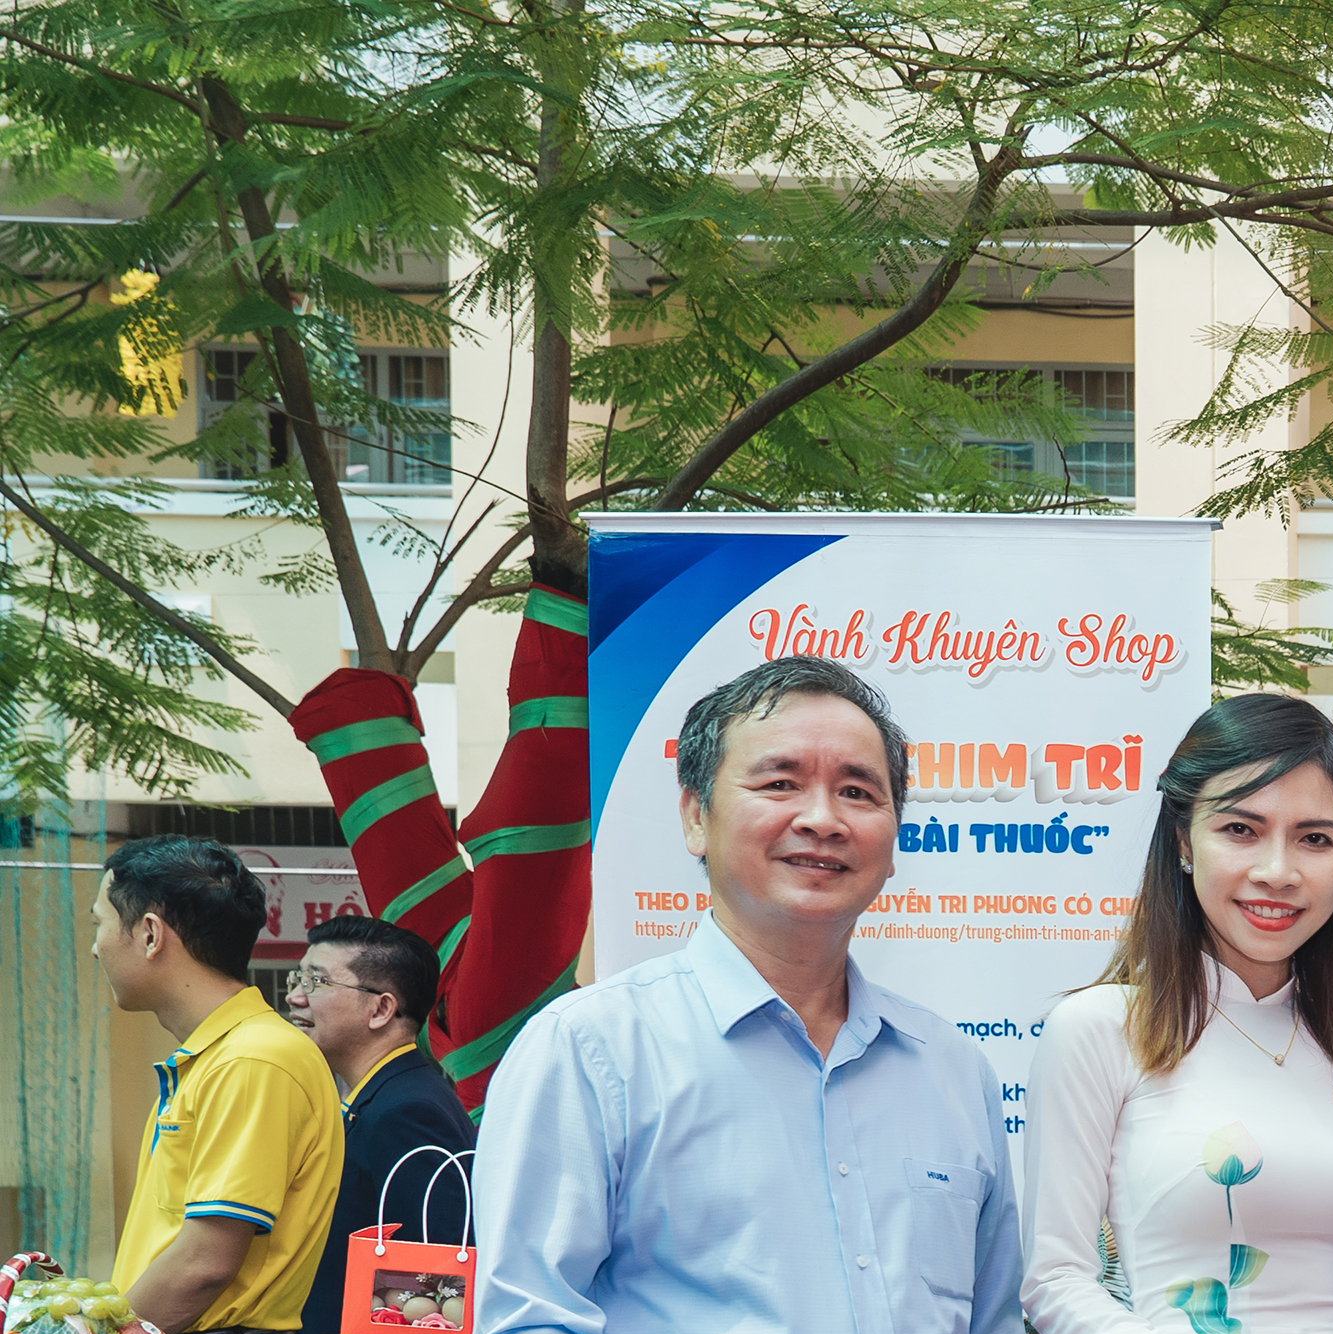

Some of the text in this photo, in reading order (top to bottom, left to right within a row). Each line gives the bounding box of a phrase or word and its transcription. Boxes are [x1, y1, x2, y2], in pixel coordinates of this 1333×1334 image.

[749, 604, 1179, 681] Vành Khuyên Shop
[1044, 734, 1143, 792] TRĨ
[899, 815, 958, 854] BÀI
[635, 891, 689, 911] THEO
[865, 887, 931, 914] GUYỄN
[938, 895, 967, 914] TRI
[973, 893, 1057, 915] PHƯƠNG
[1064, 892, 1092, 915] CÓ
